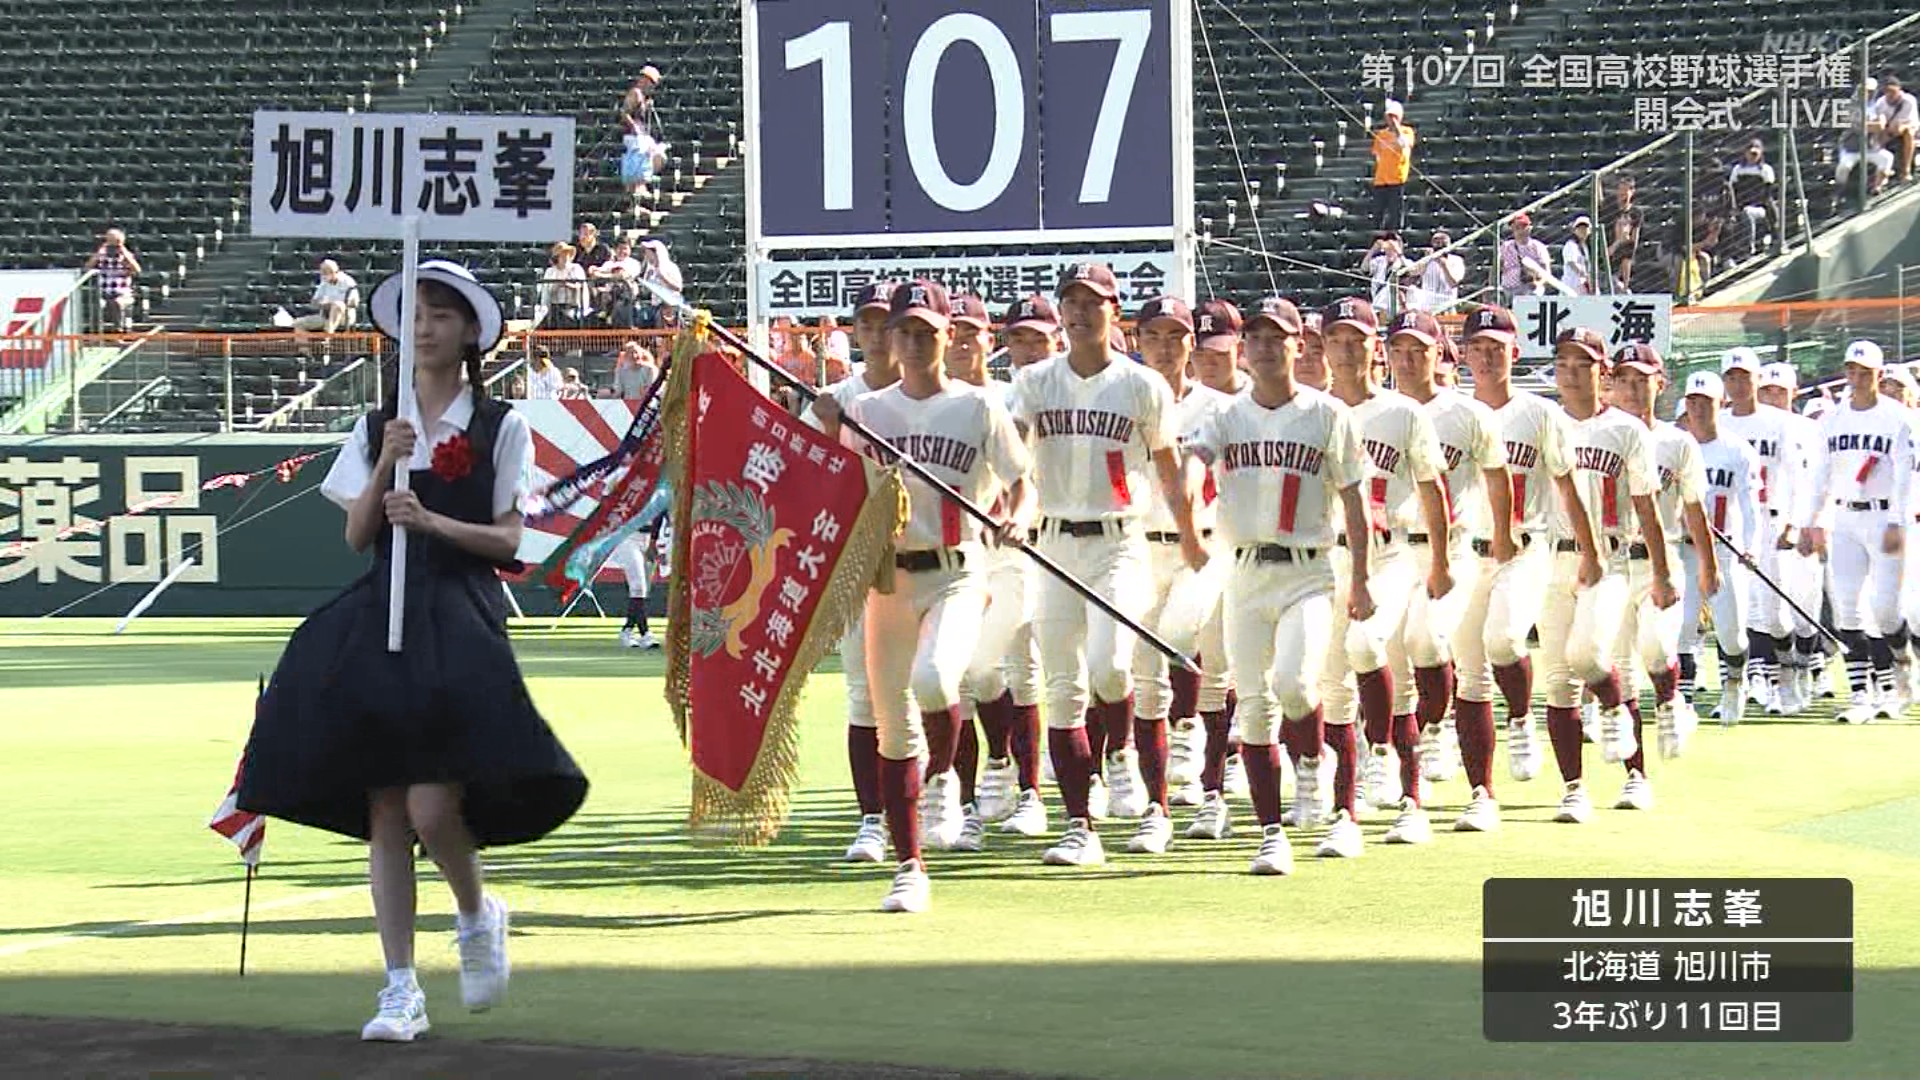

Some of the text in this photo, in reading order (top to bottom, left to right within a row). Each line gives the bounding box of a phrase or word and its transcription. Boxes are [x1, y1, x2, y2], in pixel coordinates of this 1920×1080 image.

[785, 9, 1151, 211] 107
[271, 124, 556, 218] 旭川志峯
[1527, 300, 1656, 346] 北海
[1036, 408, 1134, 444] KYOKUSHIHO
[1828, 434, 1893, 455] HOKKAI
[0, 456, 219, 584] 薬品
[738, 508, 842, 717] 北北海道大会
